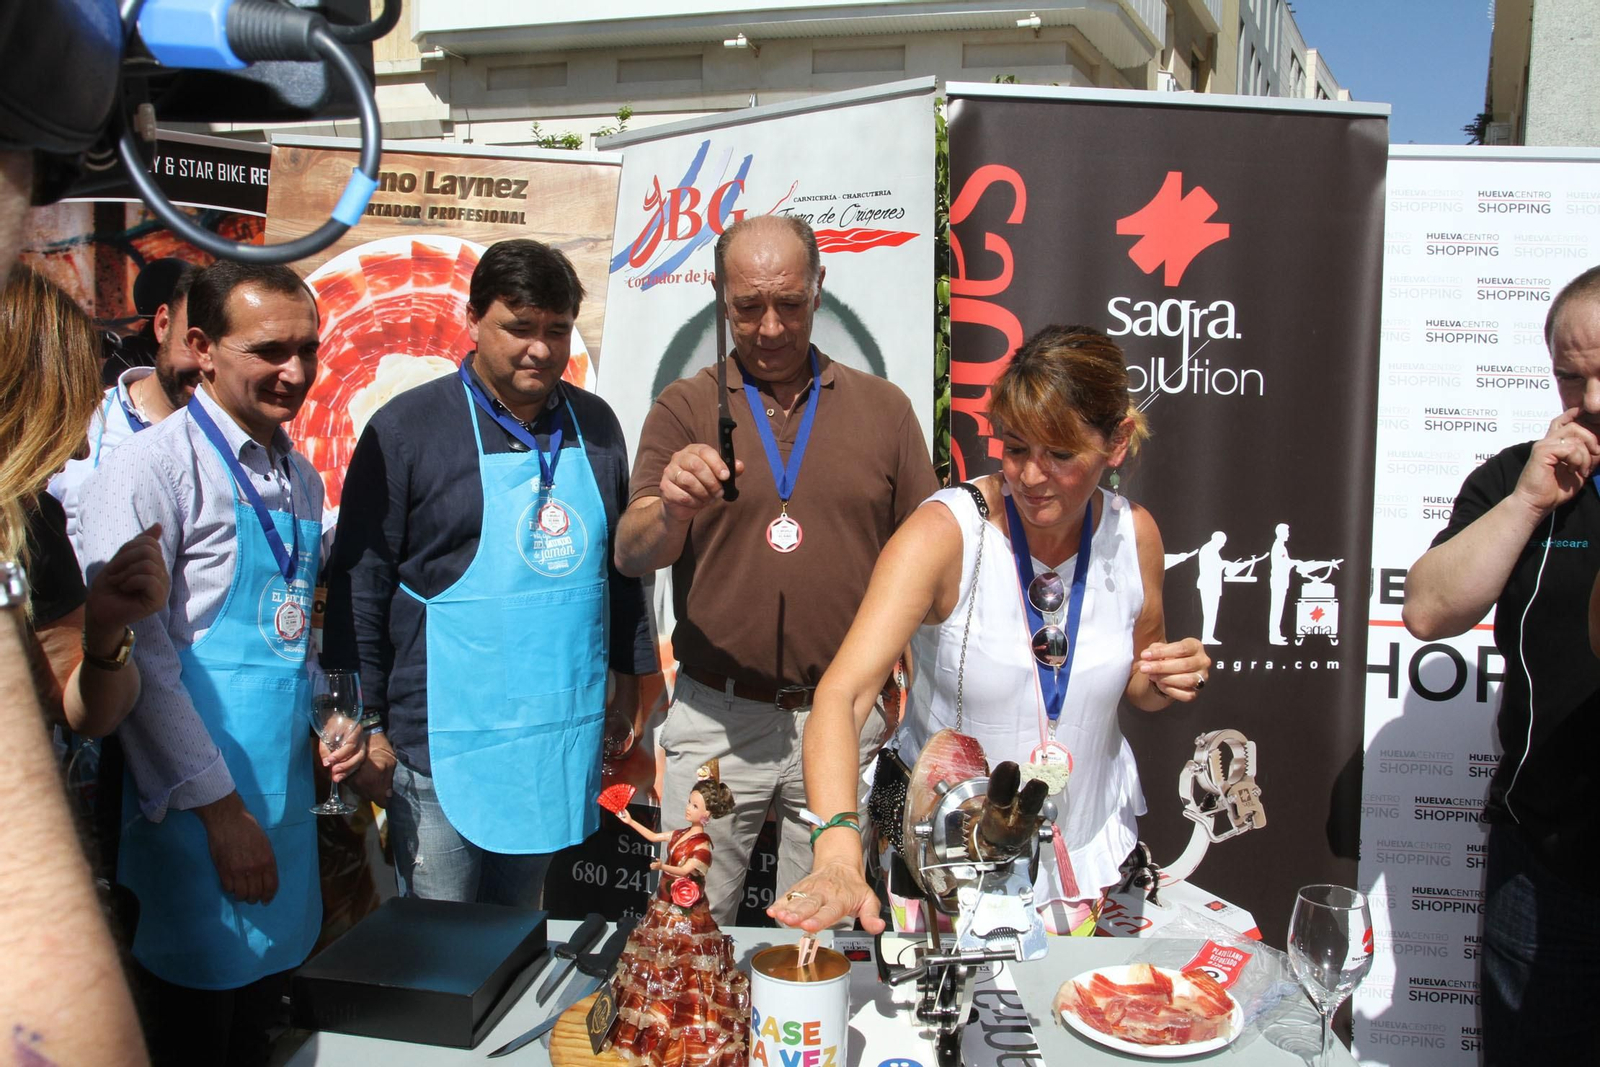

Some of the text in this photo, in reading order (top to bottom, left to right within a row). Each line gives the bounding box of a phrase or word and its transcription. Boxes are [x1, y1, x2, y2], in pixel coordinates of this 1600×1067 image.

[148, 156, 160, 174] Y
[165, 157, 175, 176] &
[180, 158, 214, 180] STAR
[218, 163, 246, 184] BIKE
[424, 170, 529, 200] Laynez
[817, 206, 836, 224] de
[1478, 202, 1552, 214] SHOPPING
[428, 206, 526, 225] PROFESIONAL
[1426, 244, 1499, 256] SHOPPING
[685, 270, 701, 282] de
[1477, 290, 1550, 302] SHOPPING
[1426, 332, 1498, 344] SHOPPING
[1476, 376, 1550, 390] SHOPPING
[1424, 420, 1498, 432] SHOPPING
[1379, 762, 1454, 776] SHOPPING
[1376, 852, 1451, 867] SHOPPING
[572, 860, 608, 886] 680
[615, 868, 652, 894] 241
[1370, 1034, 1446, 1049] SHOPPING
